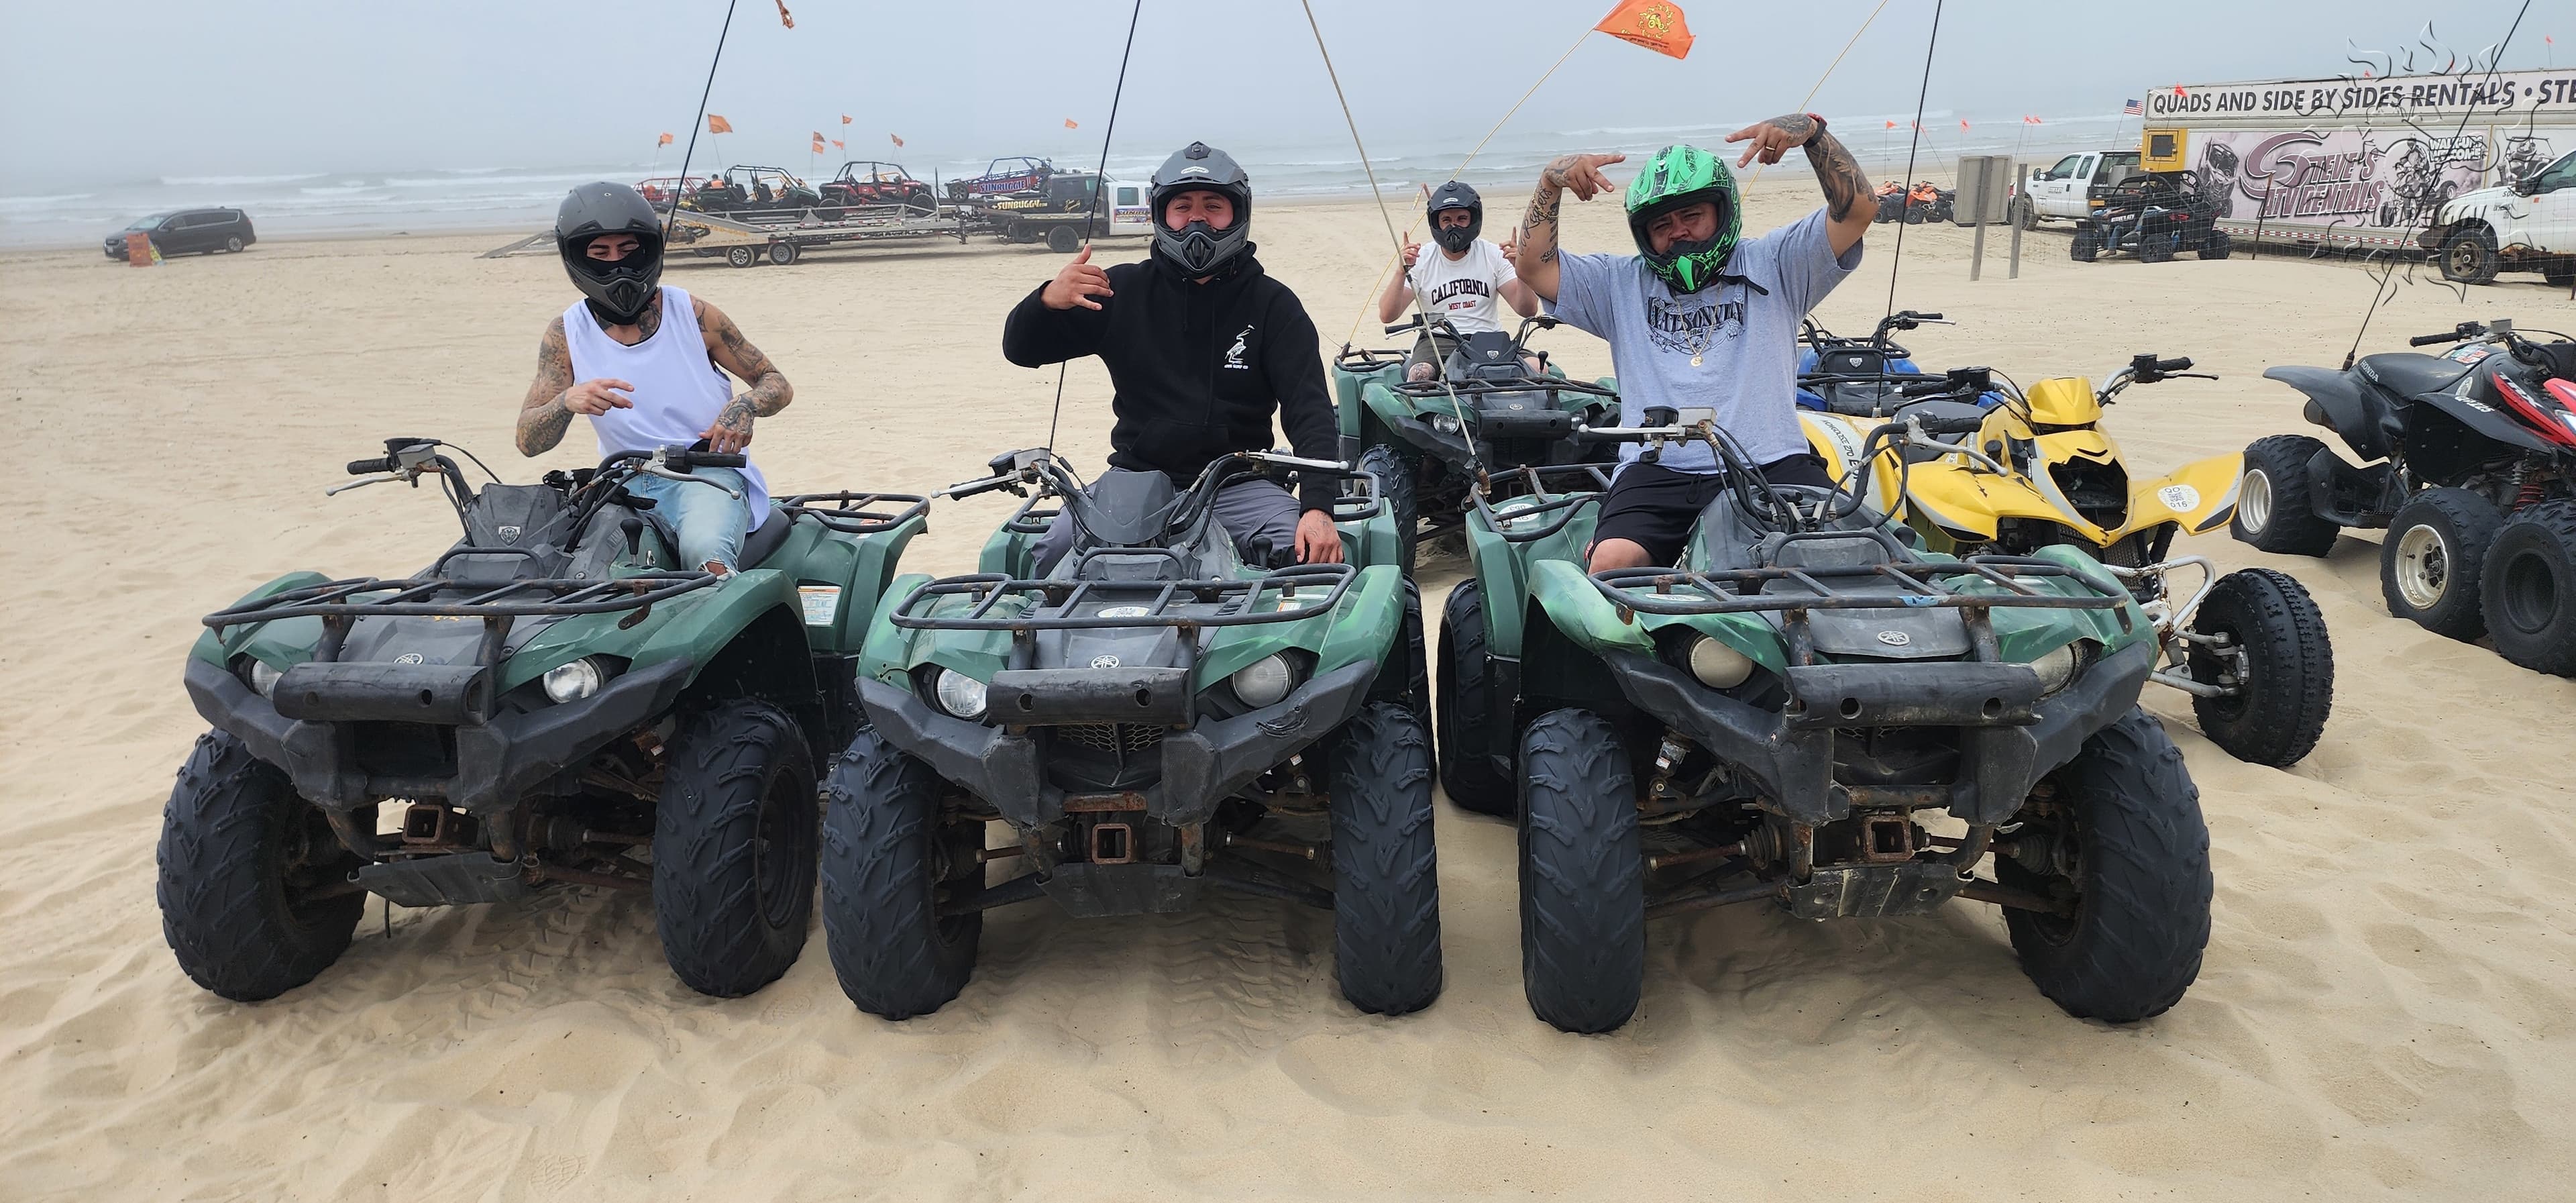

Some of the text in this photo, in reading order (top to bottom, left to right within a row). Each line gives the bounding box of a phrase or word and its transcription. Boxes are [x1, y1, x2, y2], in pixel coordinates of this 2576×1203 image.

[2153, 93, 2211, 115] QUADS
[2215, 91, 2257, 112] AND
[2262, 89, 2306, 111] SIDE
[2310, 88, 2338, 110] BY
[2343, 85, 2404, 109] SIDES
[2411, 81, 2516, 107] RENTALS
[2258, 180, 2385, 218] ATV RENTALS
[1431, 278, 1490, 306] CALIFORNIA
[1448, 300, 1477, 310] WEST COAST
[2360, 360, 2379, 382] HONDA
[2499, 371, 2546, 409] TRX
[1843, 442, 1854, 457] 270
